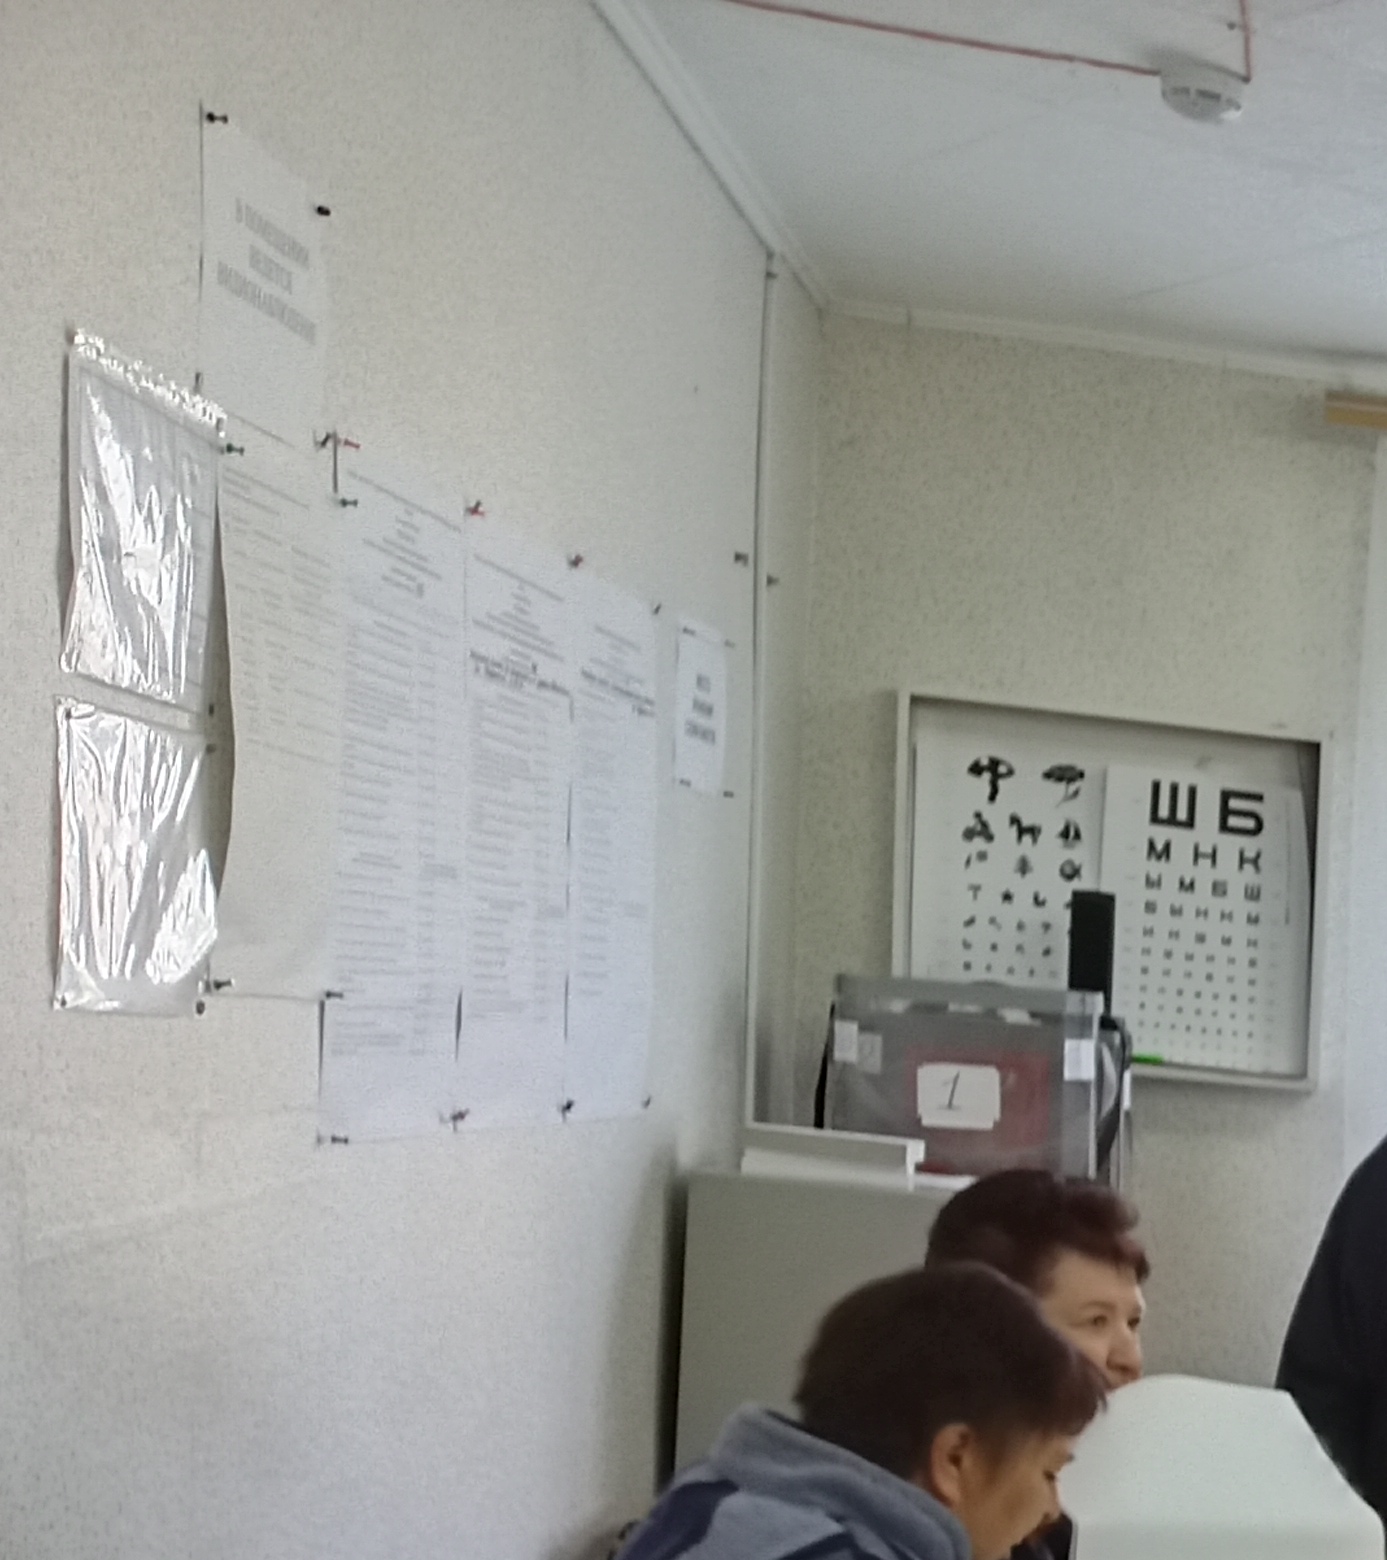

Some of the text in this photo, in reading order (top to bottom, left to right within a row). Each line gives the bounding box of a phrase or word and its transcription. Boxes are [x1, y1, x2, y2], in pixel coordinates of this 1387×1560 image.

[1149, 779, 1264, 838] Ш Б
[1146, 836, 1261, 874] М Н К
[1244, 883, 1261, 902] Ш
[936, 1069, 963, 1111] 1
